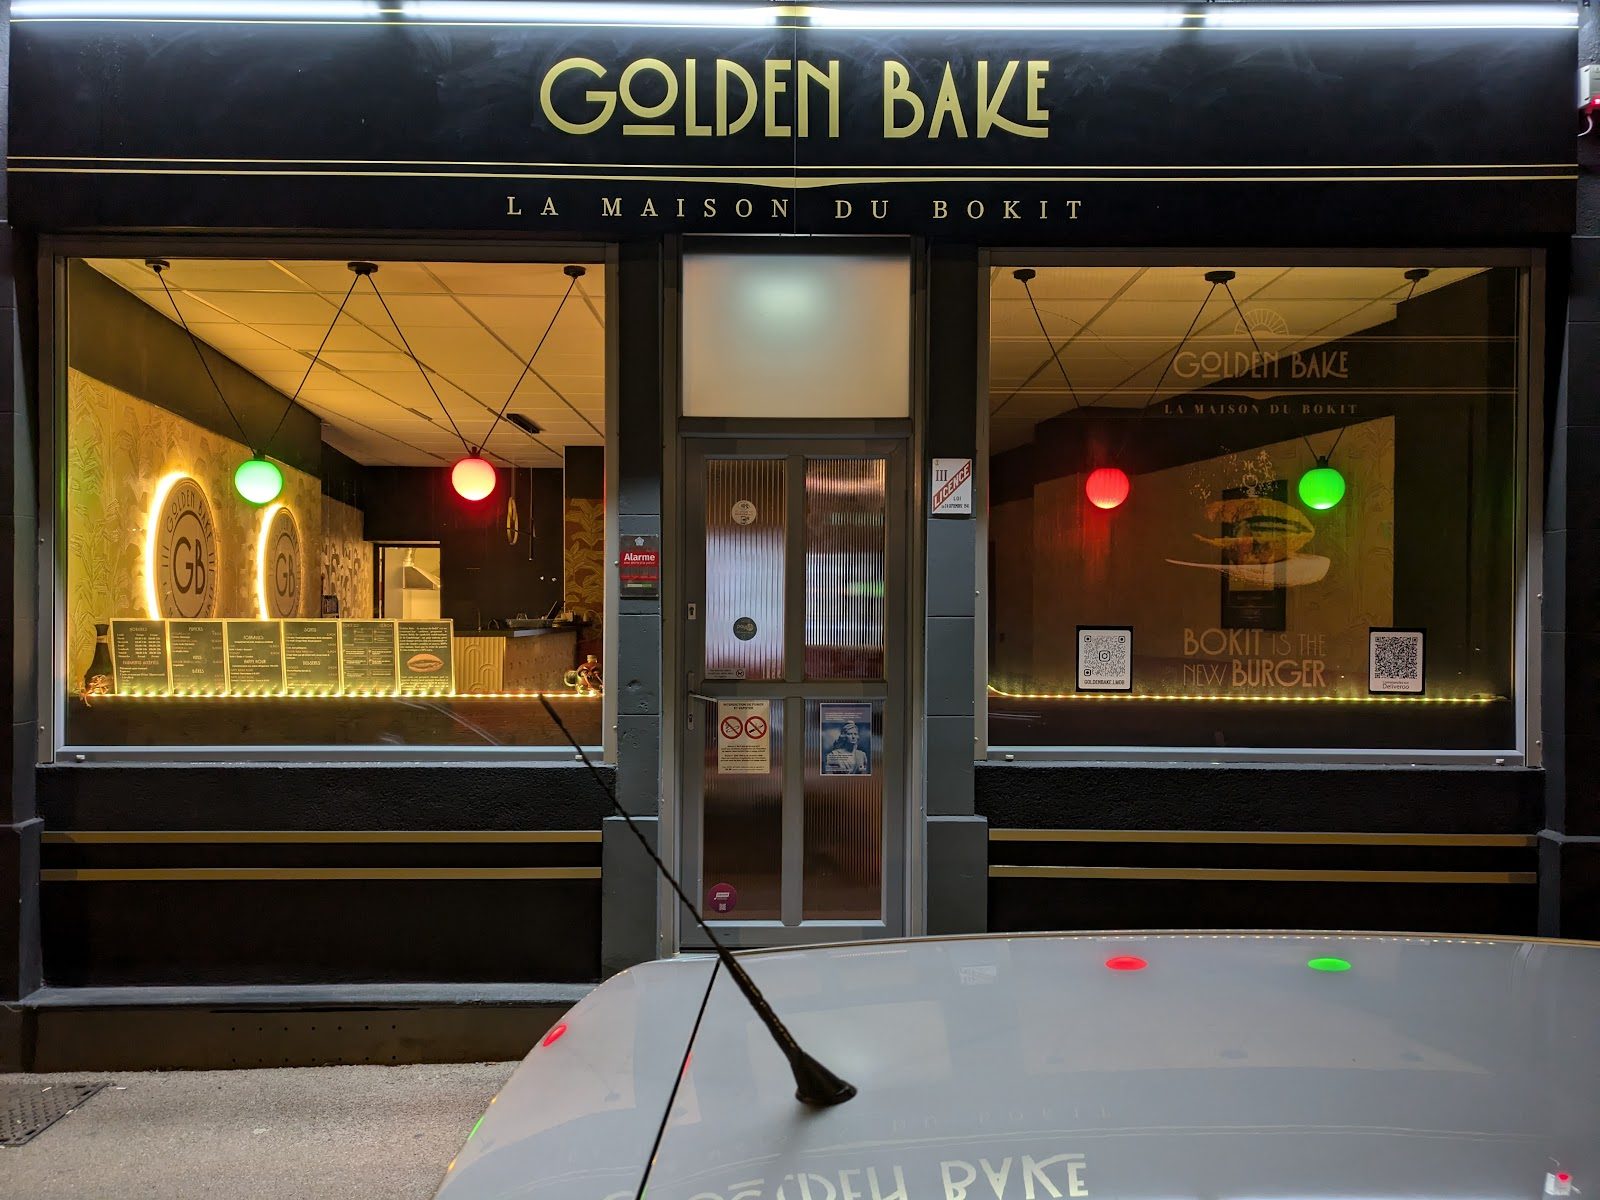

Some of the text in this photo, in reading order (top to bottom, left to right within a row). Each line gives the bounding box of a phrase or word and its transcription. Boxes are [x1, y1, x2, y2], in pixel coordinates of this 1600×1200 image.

[540, 57, 1050, 139] GOLDEN BAKE
[507, 196, 1083, 220] LA MAISON DU BOKIT
[1173, 350, 1349, 379] GOLDEN BAKE
[1164, 404, 1360, 415] LA MAISON DU BOKIT
[936, 466, 969, 507] LICENCE
[173, 536, 206, 595] GB
[624, 552, 656, 561] Alarme
[275, 552, 296, 598] GB
[1183, 628, 1327, 656] BOKIT IS THE
[1183, 660, 1326, 687] NEW BURGER
